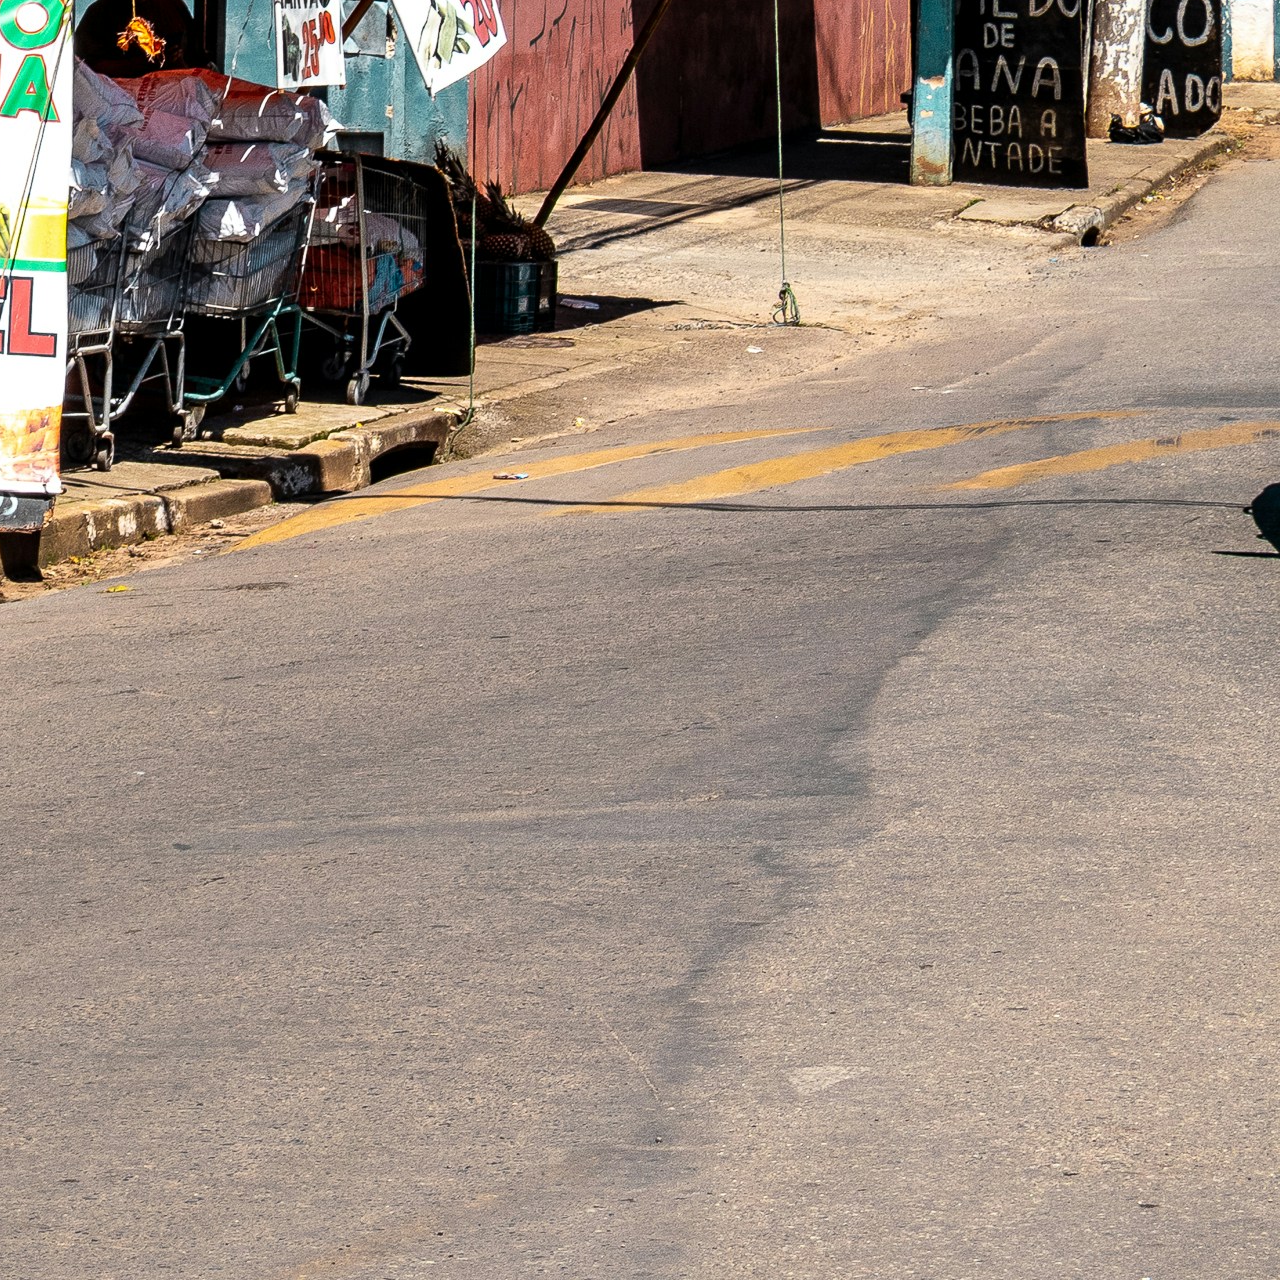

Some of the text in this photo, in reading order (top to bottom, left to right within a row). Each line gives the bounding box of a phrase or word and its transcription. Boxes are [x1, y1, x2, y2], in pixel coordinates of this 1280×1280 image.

[983, 22, 1016, 49] DE
[955, 48, 1063, 101] ANA
[953, 102, 1057, 139] BEBA A
[960, 138, 1064, 175] NTADE
